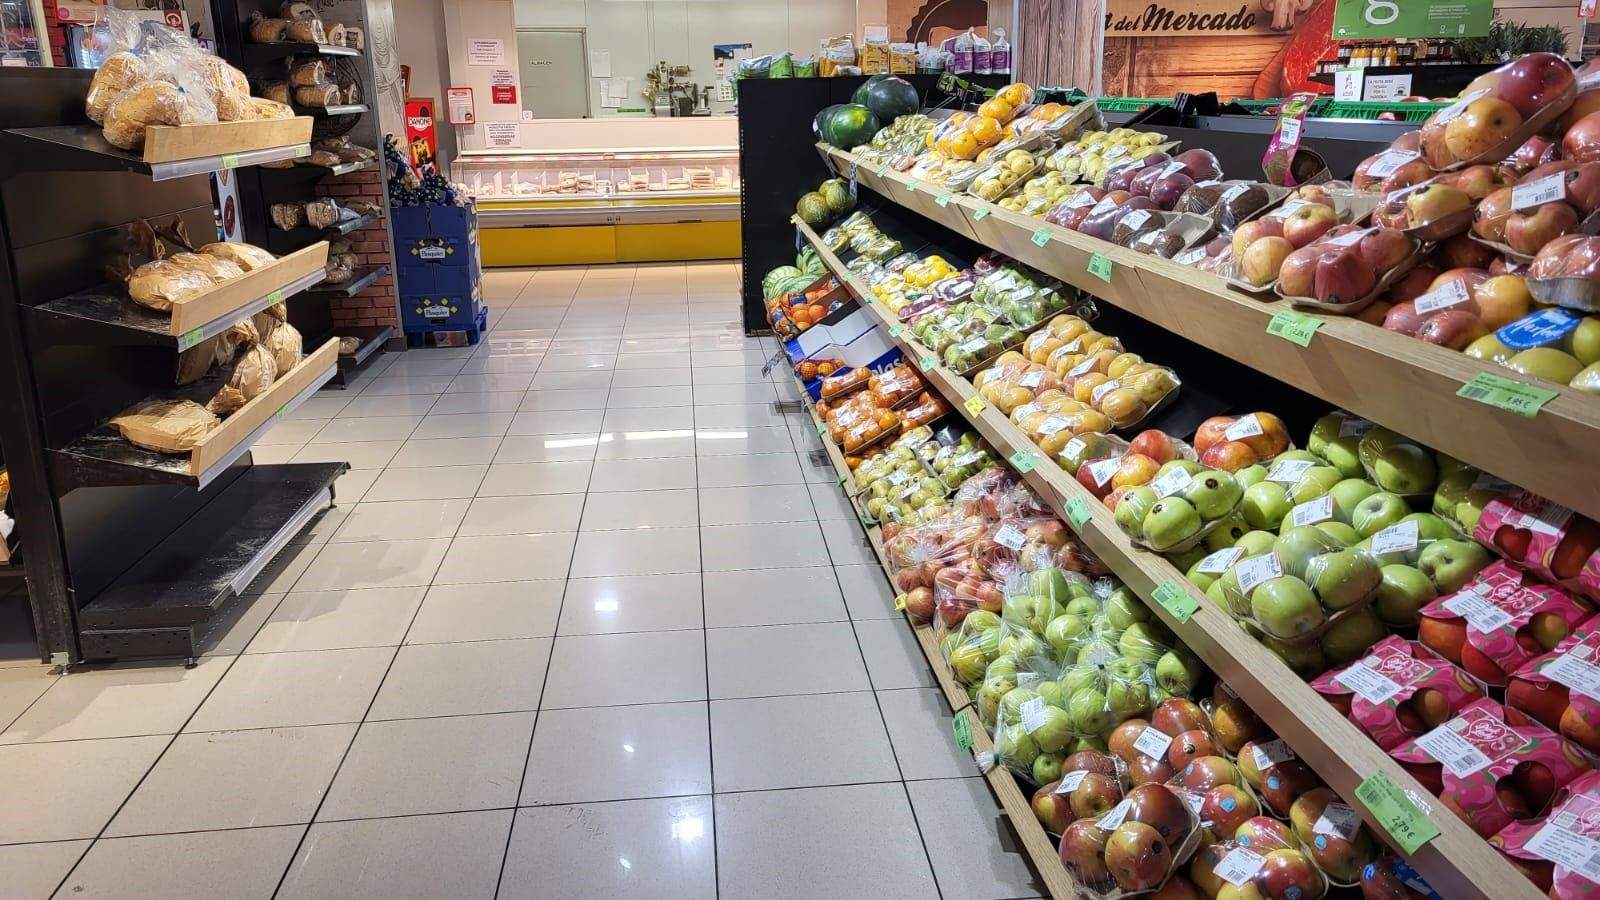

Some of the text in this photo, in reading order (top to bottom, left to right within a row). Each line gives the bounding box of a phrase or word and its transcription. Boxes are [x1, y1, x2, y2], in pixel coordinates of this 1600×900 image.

[1114, 15, 1142, 31] del
[1142, 3, 1257, 32] Mercado
[408, 117, 432, 126] DANONE
[1391, 815, 1410, 833] 2,79
